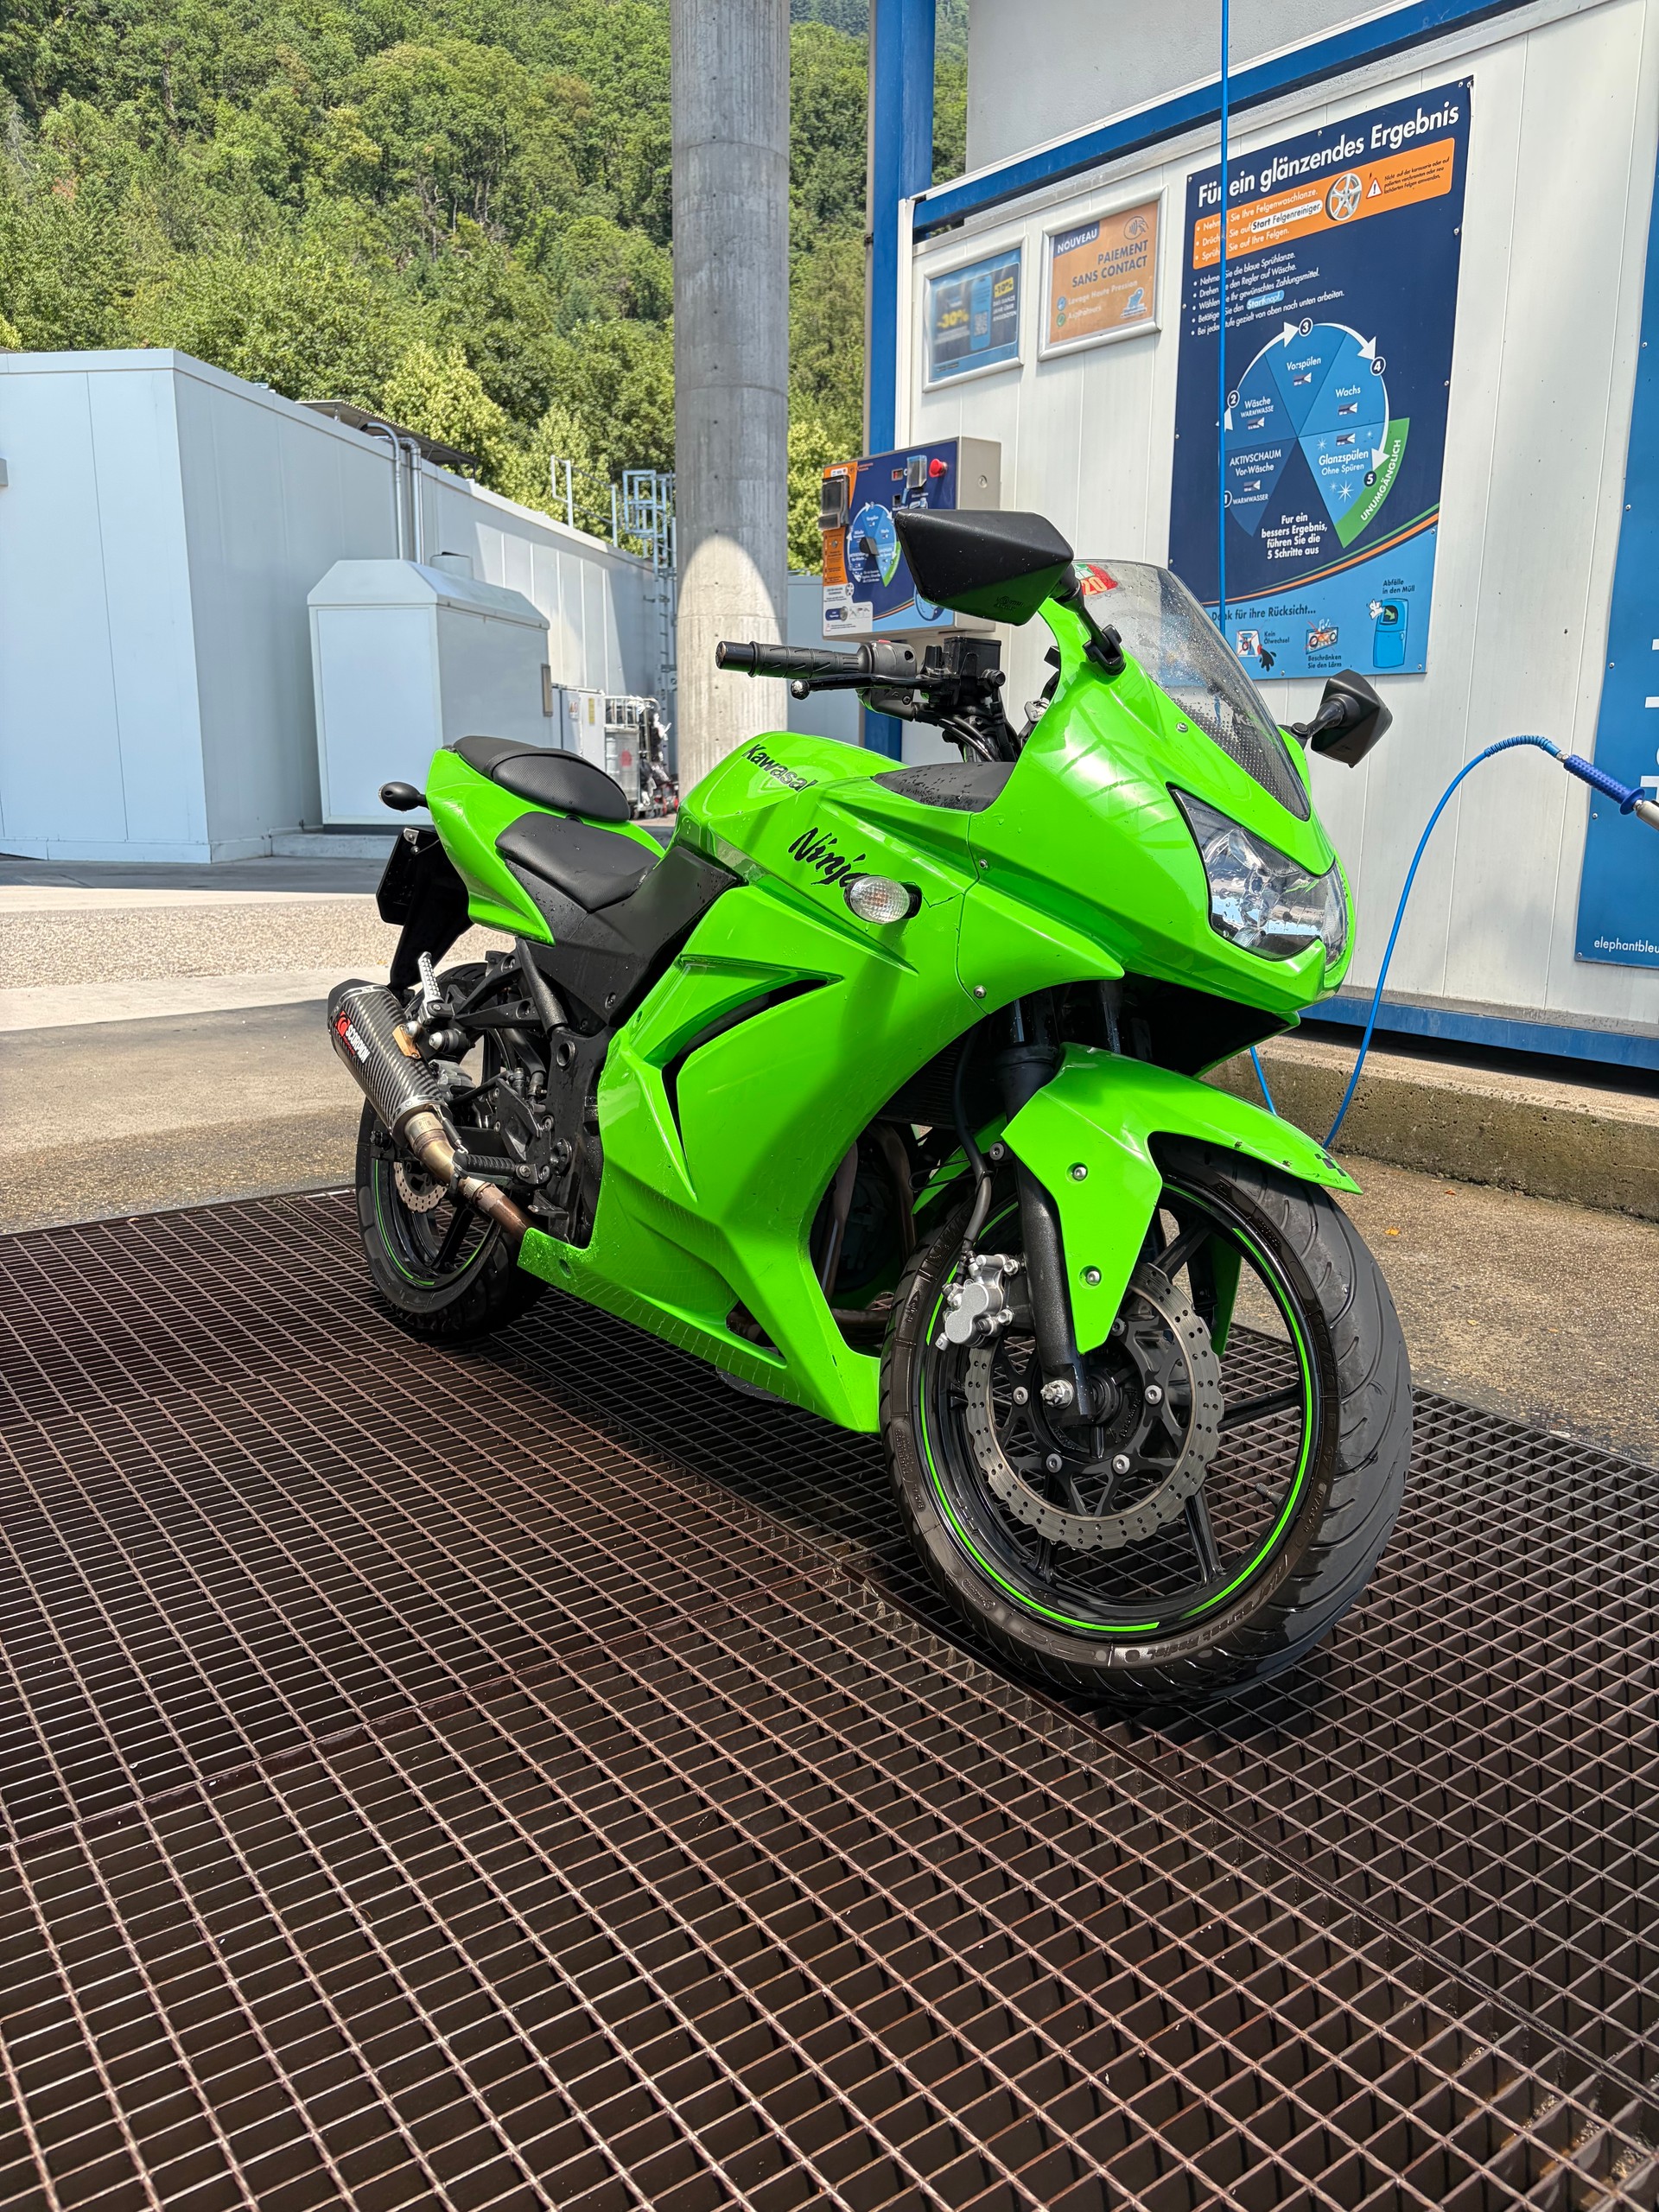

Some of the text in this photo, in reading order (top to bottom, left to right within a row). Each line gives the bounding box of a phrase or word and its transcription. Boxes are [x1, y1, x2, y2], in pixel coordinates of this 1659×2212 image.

[1229, 170, 1255, 197] ein
[1260, 134, 1364, 193] glänzendes
[1370, 101, 1459, 149] Ergebnis
[1230, 213, 1241, 222] Sie
[1242, 208, 1255, 219] Ihre
[1255, 188, 1318, 213] Felgenwaschlanze.
[1229, 229, 1239, 238] Sie
[1240, 222, 1251, 234] auf
[1252, 218, 1271, 231] Start
[1272, 203, 1322, 224] Felgenreiniger.
[1057, 228, 1097, 254] NOUVEAU
[1229, 243, 1238, 252] Sie
[1239, 237, 1250, 249] auf
[1252, 235, 1264, 245] Ihre
[1266, 228, 1290, 240] Felgen.
[1097, 239, 1148, 265] PAIEMENT
[1072, 255, 1147, 288] SANS CONTACT
[1200, 274, 1221, 286] Nehme
[1233, 265, 1243, 276] die
[1243, 263, 1261, 273] blaue
[1261, 252, 1296, 269] Sprühlanze.
[1198, 286, 1219, 298] Drehen
[1230, 279, 1241, 289] den
[1242, 272, 1260, 286] Regler
[1261, 268, 1271, 280] auf
[1271, 262, 1297, 276] Wäsche.
[1275, 267, 1320, 289] Zahlungsmittel.
[995, 279, 1013, 294] -10%
[1197, 326, 1206, 336] Bei
[1267, 306, 1282, 316] oben
[1282, 299, 1298, 311] nach
[1299, 296, 1316, 308] unten
[1317, 290, 1345, 302] arbeiten.
[1233, 303, 1244, 314] den
[1302, 321, 1309, 334] 3
[1286, 356, 1321, 372] Vorspülen
[1373, 360, 1381, 372] 4
[1230, 394, 1236, 404] 2
[1335, 385, 1361, 398] Wachs
[1244, 396, 1271, 409] Wäsche
[1229, 449, 1281, 467] AKTIVSCHAUM
[1318, 448, 1369, 466] Glanzspülen
[1321, 462, 1364, 476] Ohne Spüren
[1360, 439, 1402, 521] UNUMGÄNGLICH
[1366, 474, 1374, 485] 5
[1232, 493, 1269, 505] WARMWASSER
[1281, 512, 1308, 525] Fur ein
[1262, 521, 1328, 538] bessers Ergebnis,
[1267, 533, 1321, 549] führen Sie die
[1267, 546, 1319, 560] 5 Schritte aus
[1382, 578, 1404, 587] Abfälle
[1235, 609, 1248, 620] für
[1249, 607, 1266, 619] ihre
[1268, 604, 1316, 617] Rücksicht...
[346, 1024, 371, 1064] SCORPION
